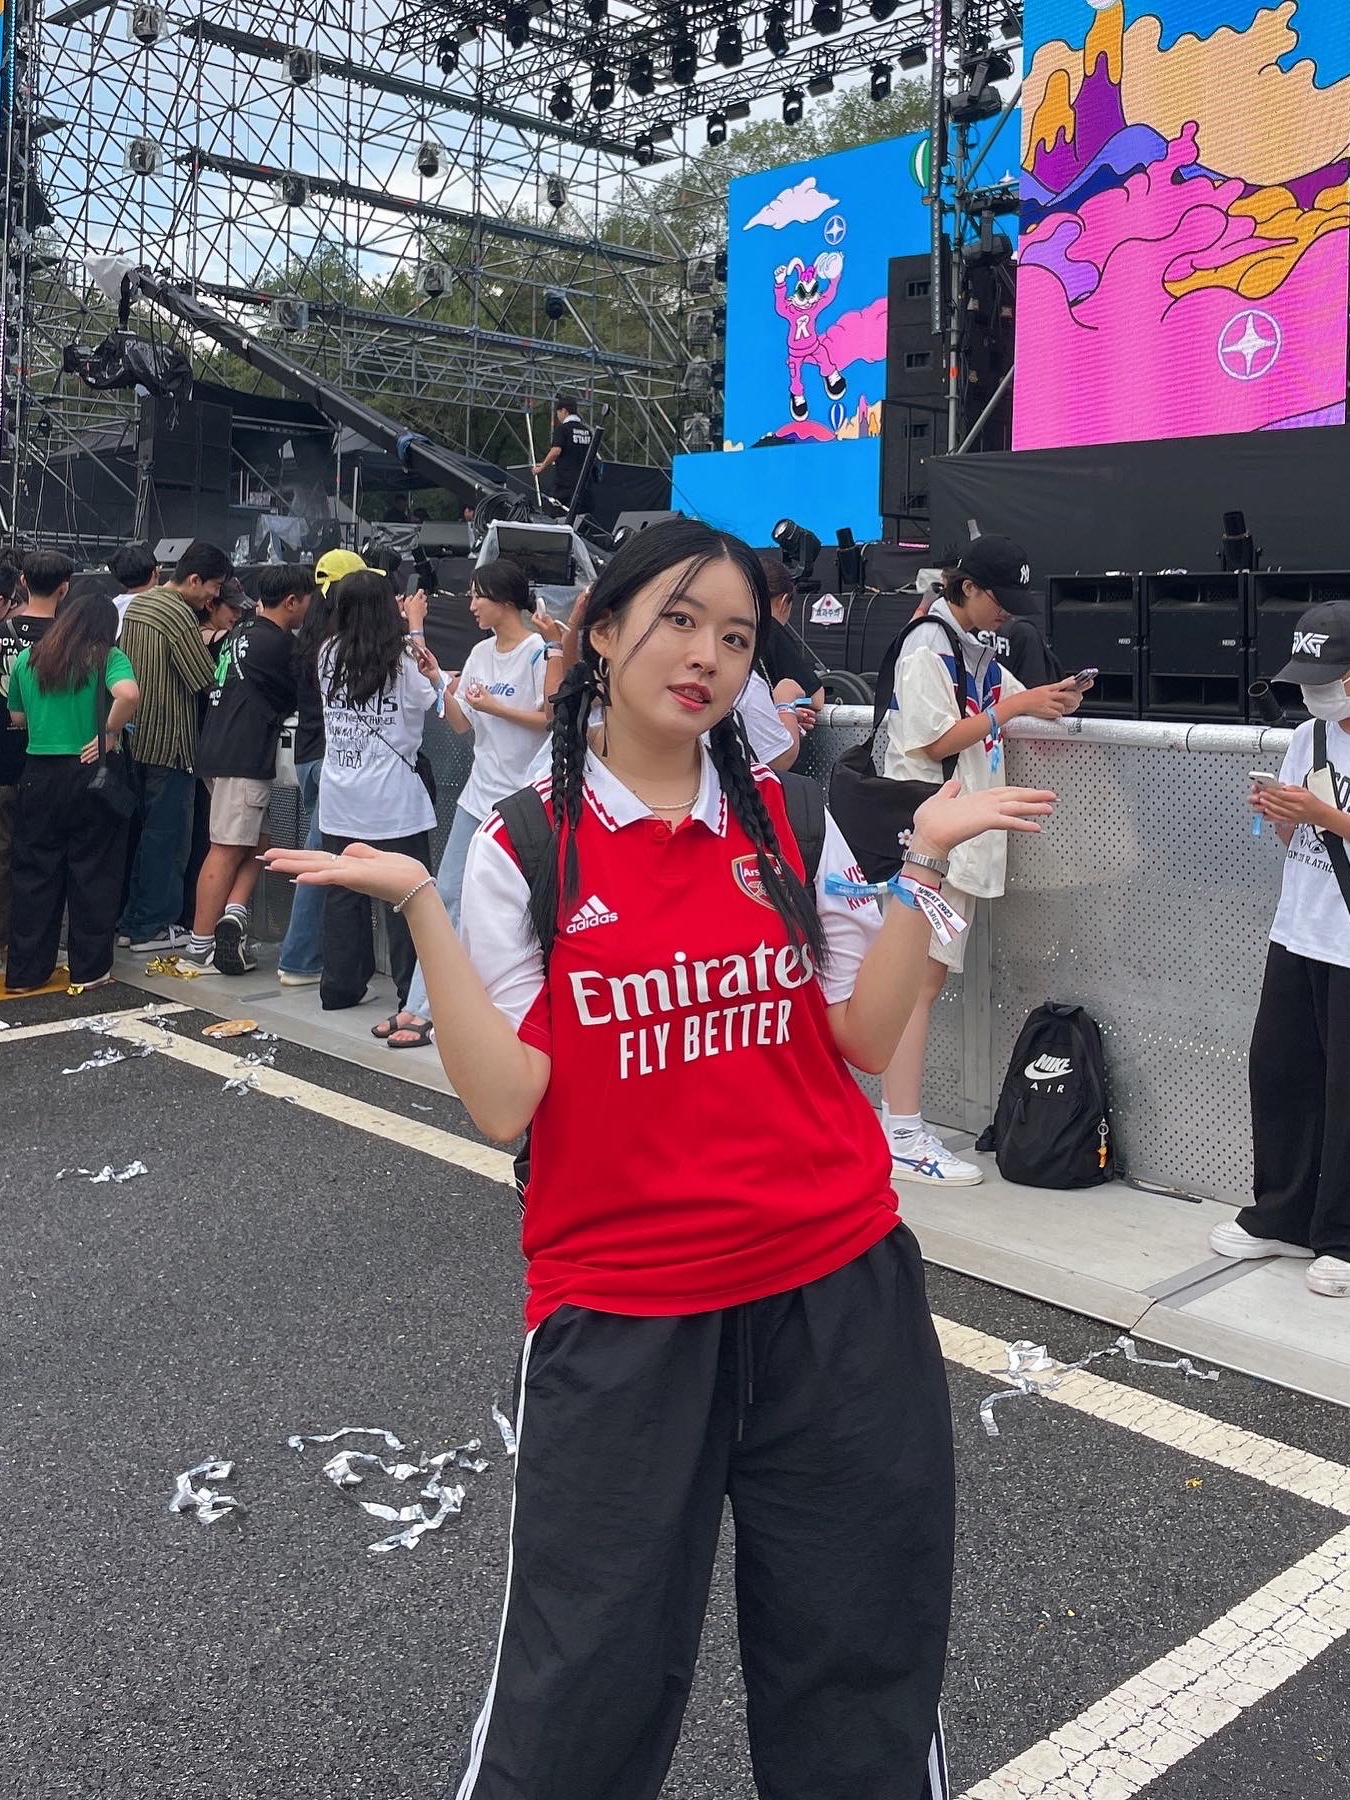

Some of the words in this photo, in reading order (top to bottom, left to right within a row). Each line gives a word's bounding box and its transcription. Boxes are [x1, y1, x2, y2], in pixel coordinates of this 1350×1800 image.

[566, 911, 618, 934] adidas
[568, 939, 814, 1026] Emirates
[620, 1022, 670, 1079] FLY
[684, 999, 792, 1062] BETTER
[1034, 1053, 1071, 1073] NIKE
[1030, 1082, 1065, 1093] AIR
